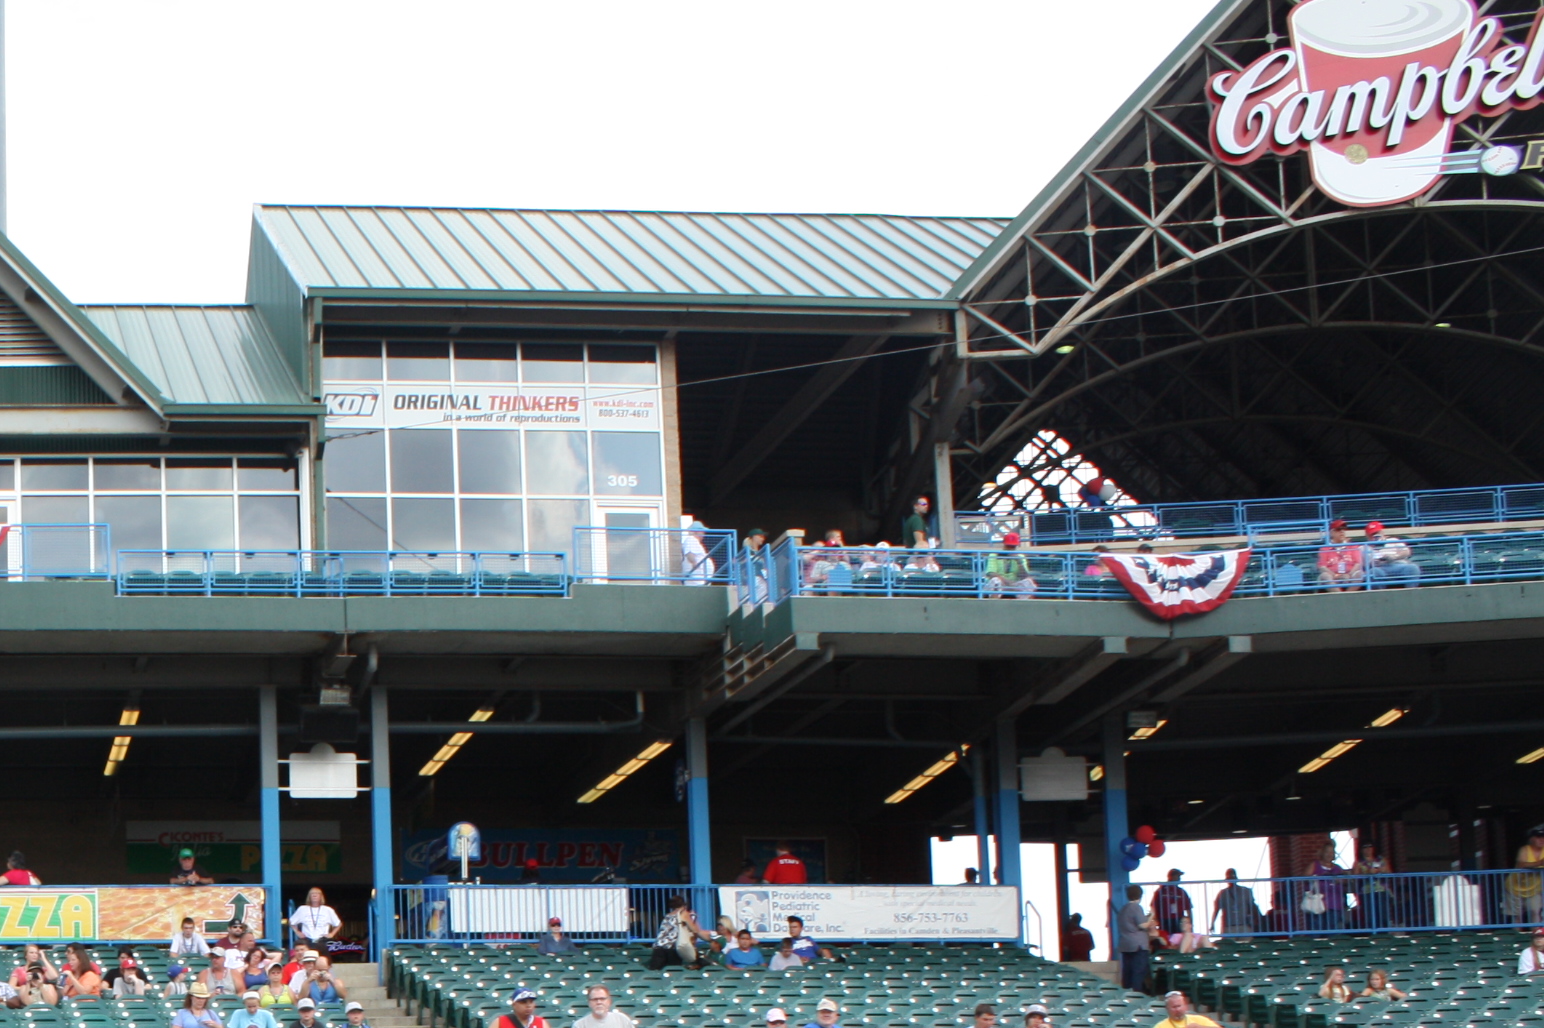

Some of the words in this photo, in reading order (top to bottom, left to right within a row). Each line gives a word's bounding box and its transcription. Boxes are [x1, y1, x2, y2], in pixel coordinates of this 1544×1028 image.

[324, 393, 380, 417] KDI
[393, 394, 482, 411] ORIGINAL
[488, 394, 580, 412] THINKERS
[443, 412, 453, 422] in
[465, 413, 493, 423] world
[496, 413, 507, 423] of
[510, 414, 580, 425] reproductions
[607, 475, 637, 487] 305
[158, 831, 224, 848] CICONTE'S
[771, 891, 832, 900] Providence
[772, 902, 820, 911] Pediatric
[773, 912, 815, 922] Mecal
[893, 913, 969, 923] 856-753-7763
[826, 923, 844, 933] Inc.
